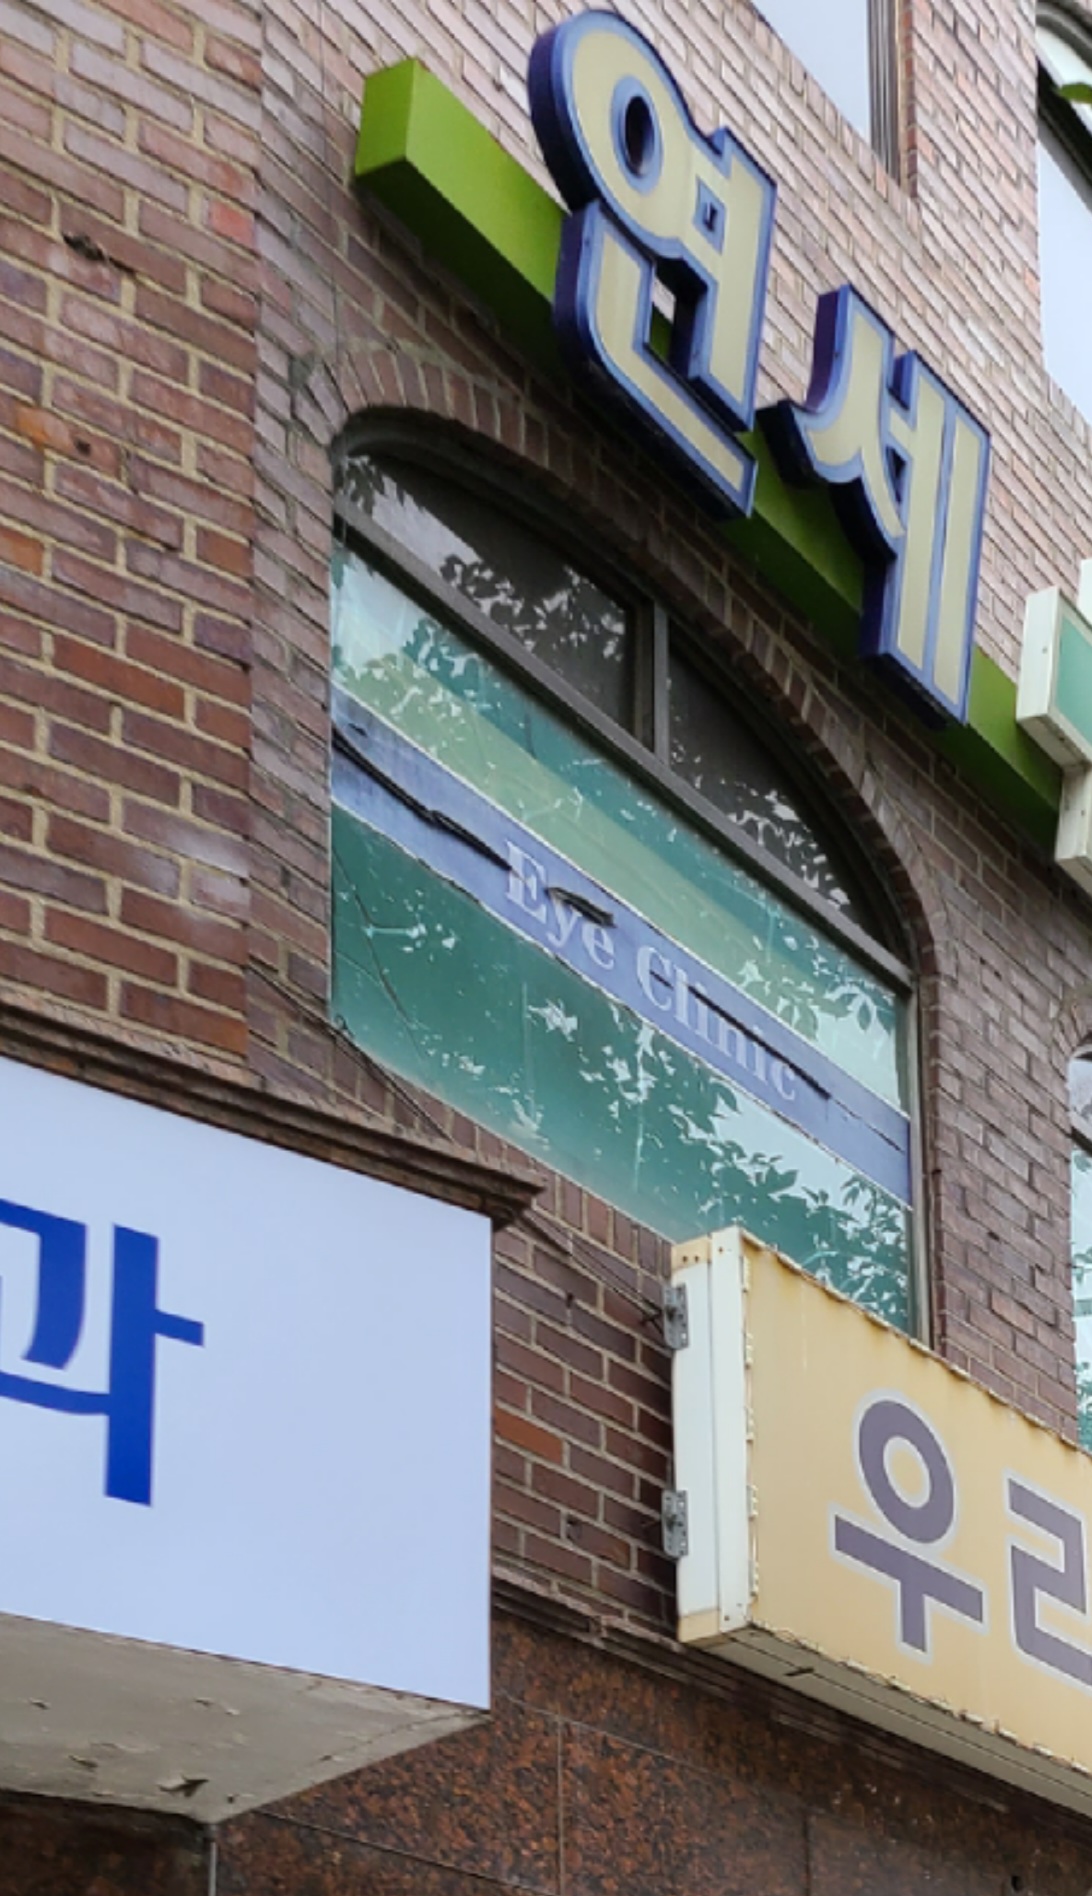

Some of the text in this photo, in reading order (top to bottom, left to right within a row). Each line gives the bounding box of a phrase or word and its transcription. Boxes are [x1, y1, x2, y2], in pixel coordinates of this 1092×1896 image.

[528, 8, 992, 728] 연세
[503, 838, 800, 1102] Eye Clinic
